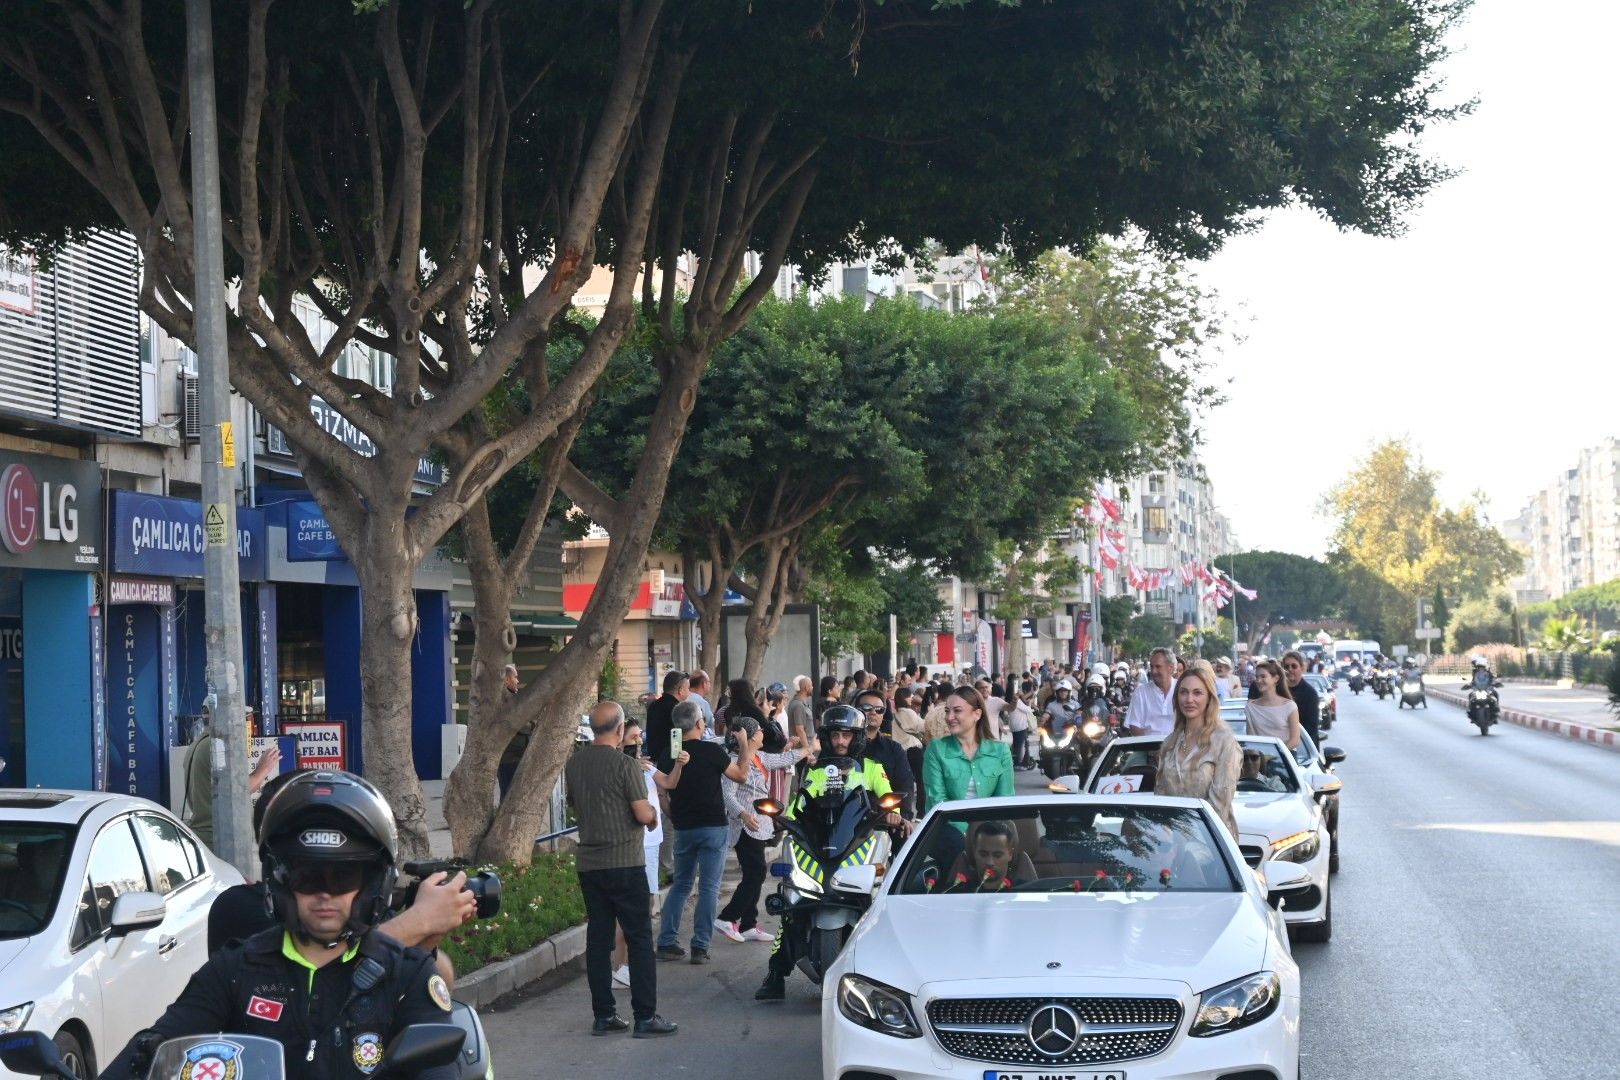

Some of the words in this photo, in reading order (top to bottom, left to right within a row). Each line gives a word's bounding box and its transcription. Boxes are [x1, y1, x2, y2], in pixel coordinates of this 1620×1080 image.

[43, 481, 79, 543] LG
[299, 519, 329, 532] ÇAML
[132, 516, 191, 555] ÇAMLICA
[297, 531, 323, 541] CAFE
[110, 581, 140, 601] ÇAMLICA
[141, 584, 158, 600] CAFE
[158, 585, 172, 602] BAR
[125, 614, 136, 700] ÇAMLICA
[166, 610, 174, 696] ÇAMLICA
[261, 610, 270, 690] ÇAMLICA
[127, 704, 136, 754] CAFE
[299, 731, 338, 742] AMLICA
[318, 747, 339, 756] BAR
[128, 759, 137, 795] BAR
[304, 832, 340, 845] SHOEI
